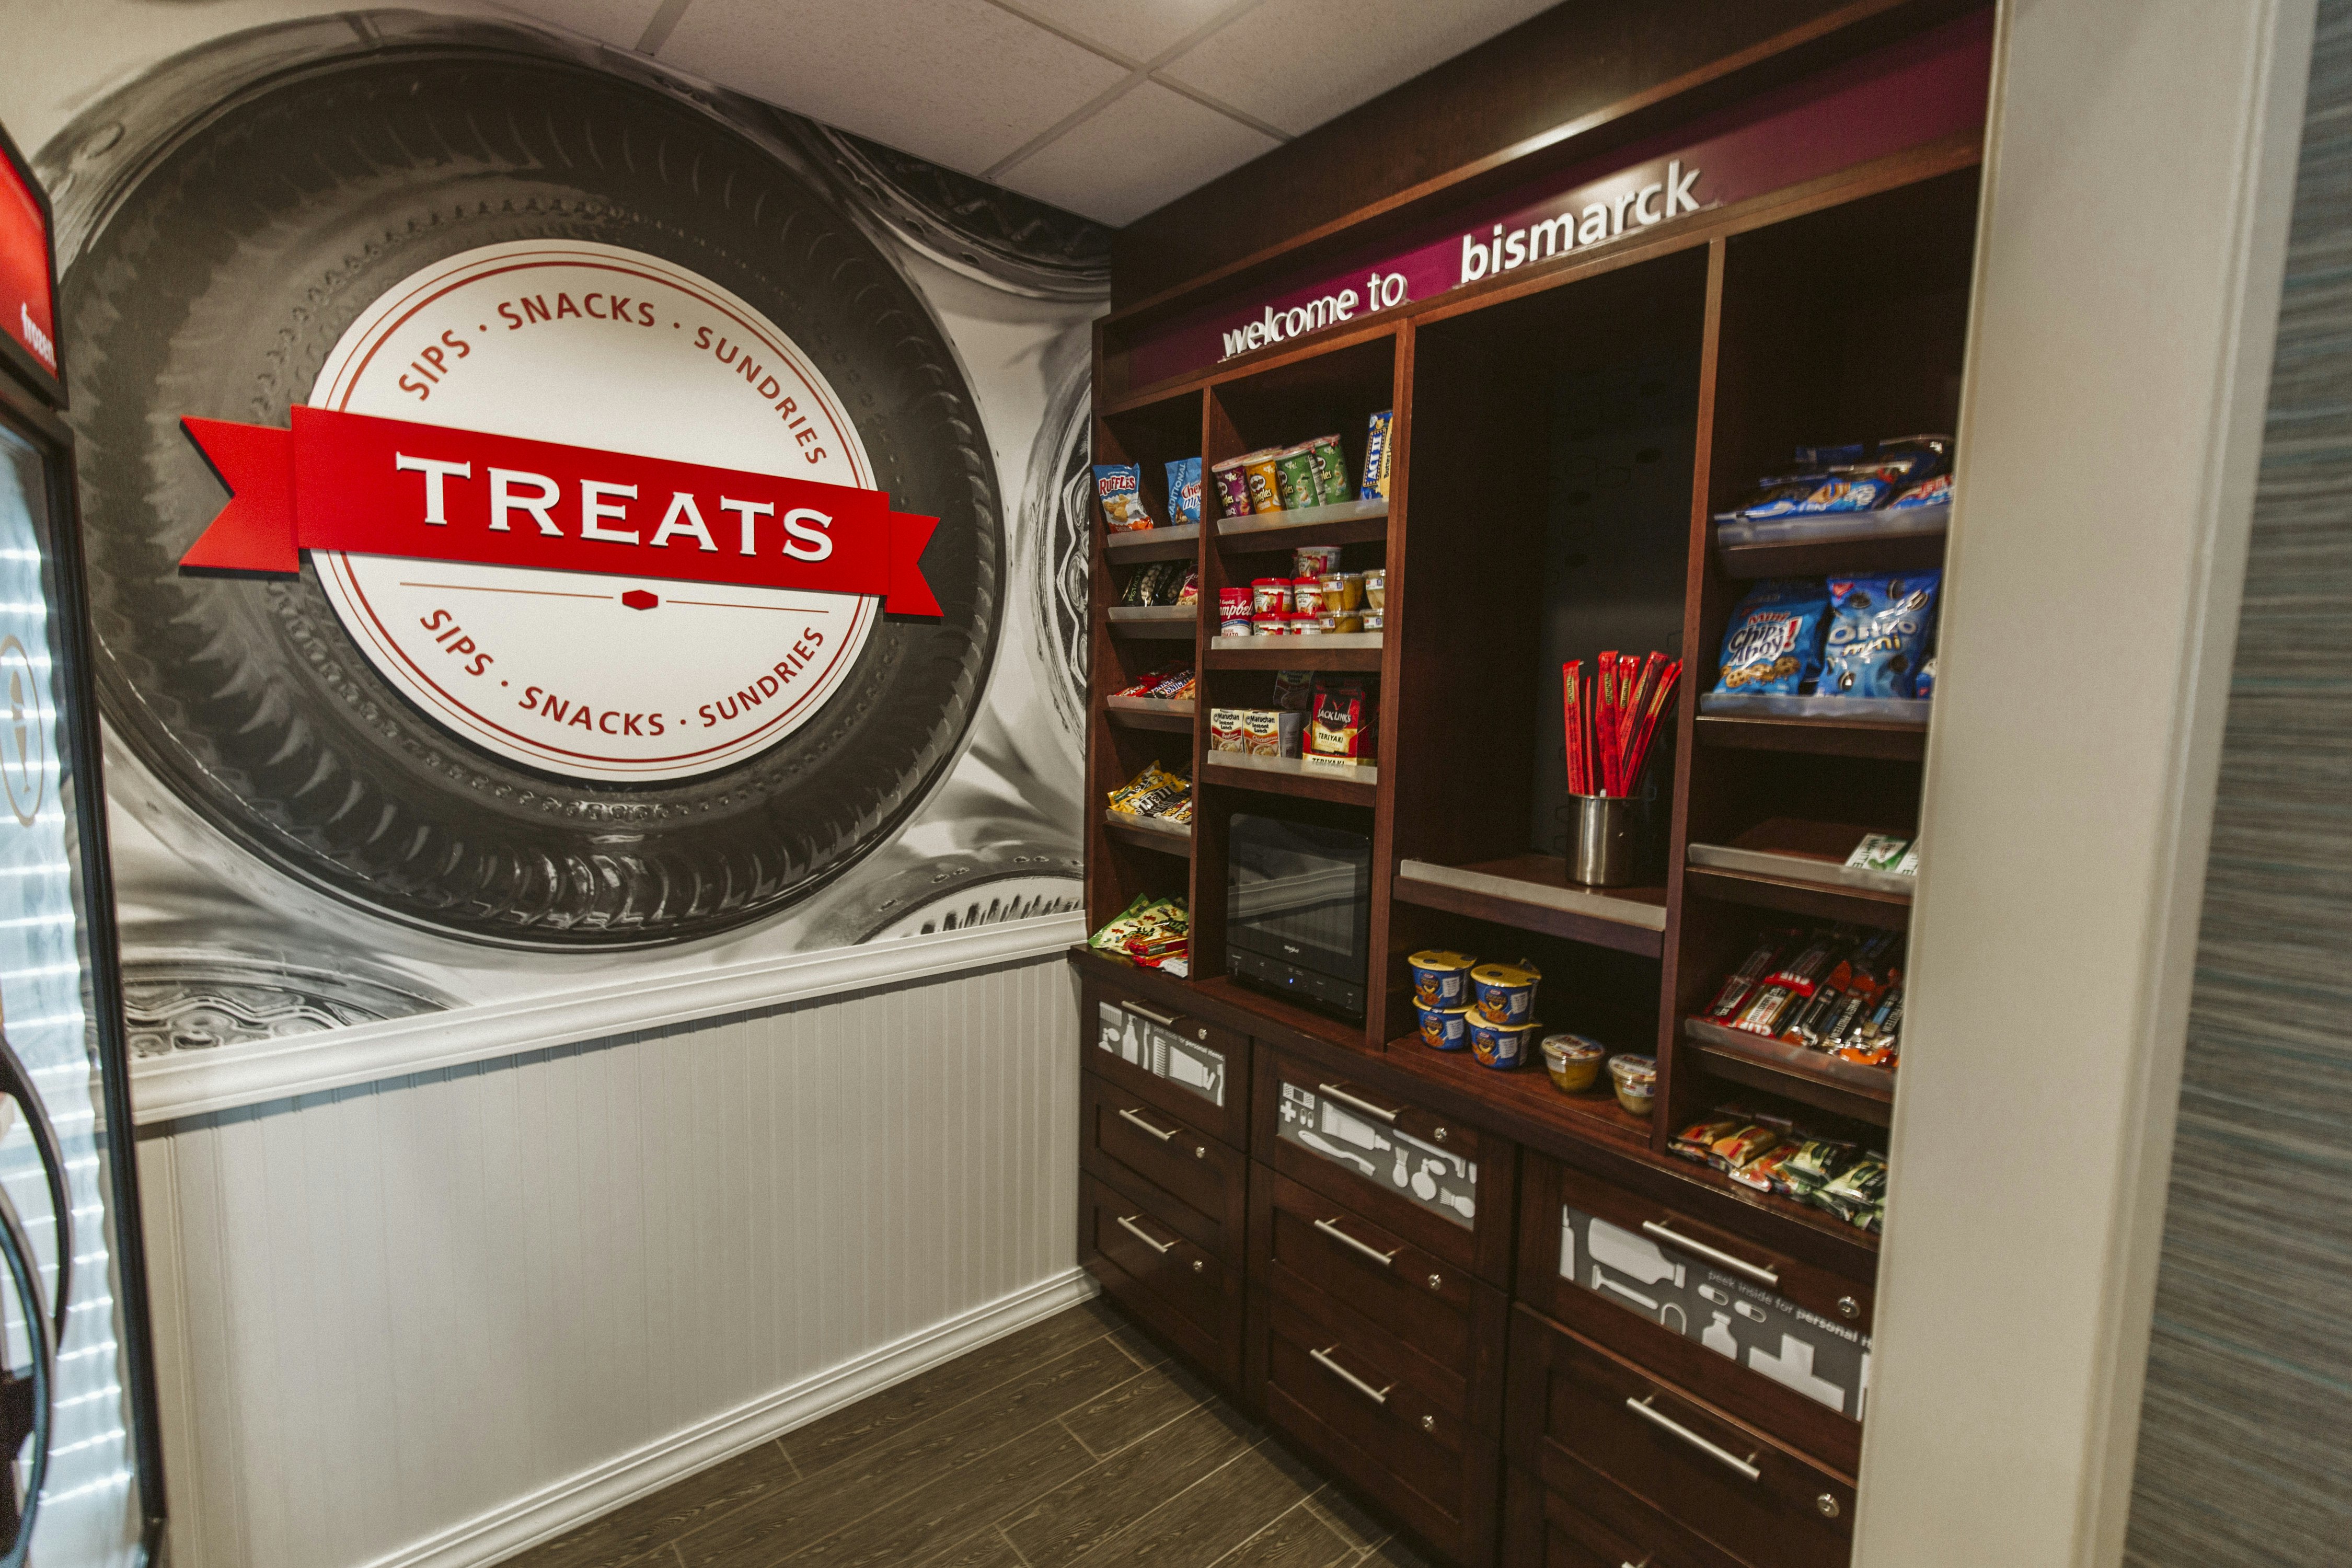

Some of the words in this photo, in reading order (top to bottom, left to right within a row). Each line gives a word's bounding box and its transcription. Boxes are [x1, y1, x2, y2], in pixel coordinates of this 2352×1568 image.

[1223, 288, 1359, 356] welcome
[1368, 273, 1408, 311] to
[1461, 160, 1700, 283] bismarck
[398, 330, 470, 400] SIPS
[497, 292, 655, 330] SNACKS
[694, 326, 826, 465] SUNDRIES
[395, 451, 833, 562] TREATS
[1099, 476, 1135, 495] RUFFLES
[420, 609, 493, 676] SIPS
[518, 686, 665, 736] SNACKS
[698, 627, 824, 727] SUNDRIES
[1319, 733, 1343, 743] TERIYAKI
[1796, 1308, 1858, 1342] personal
